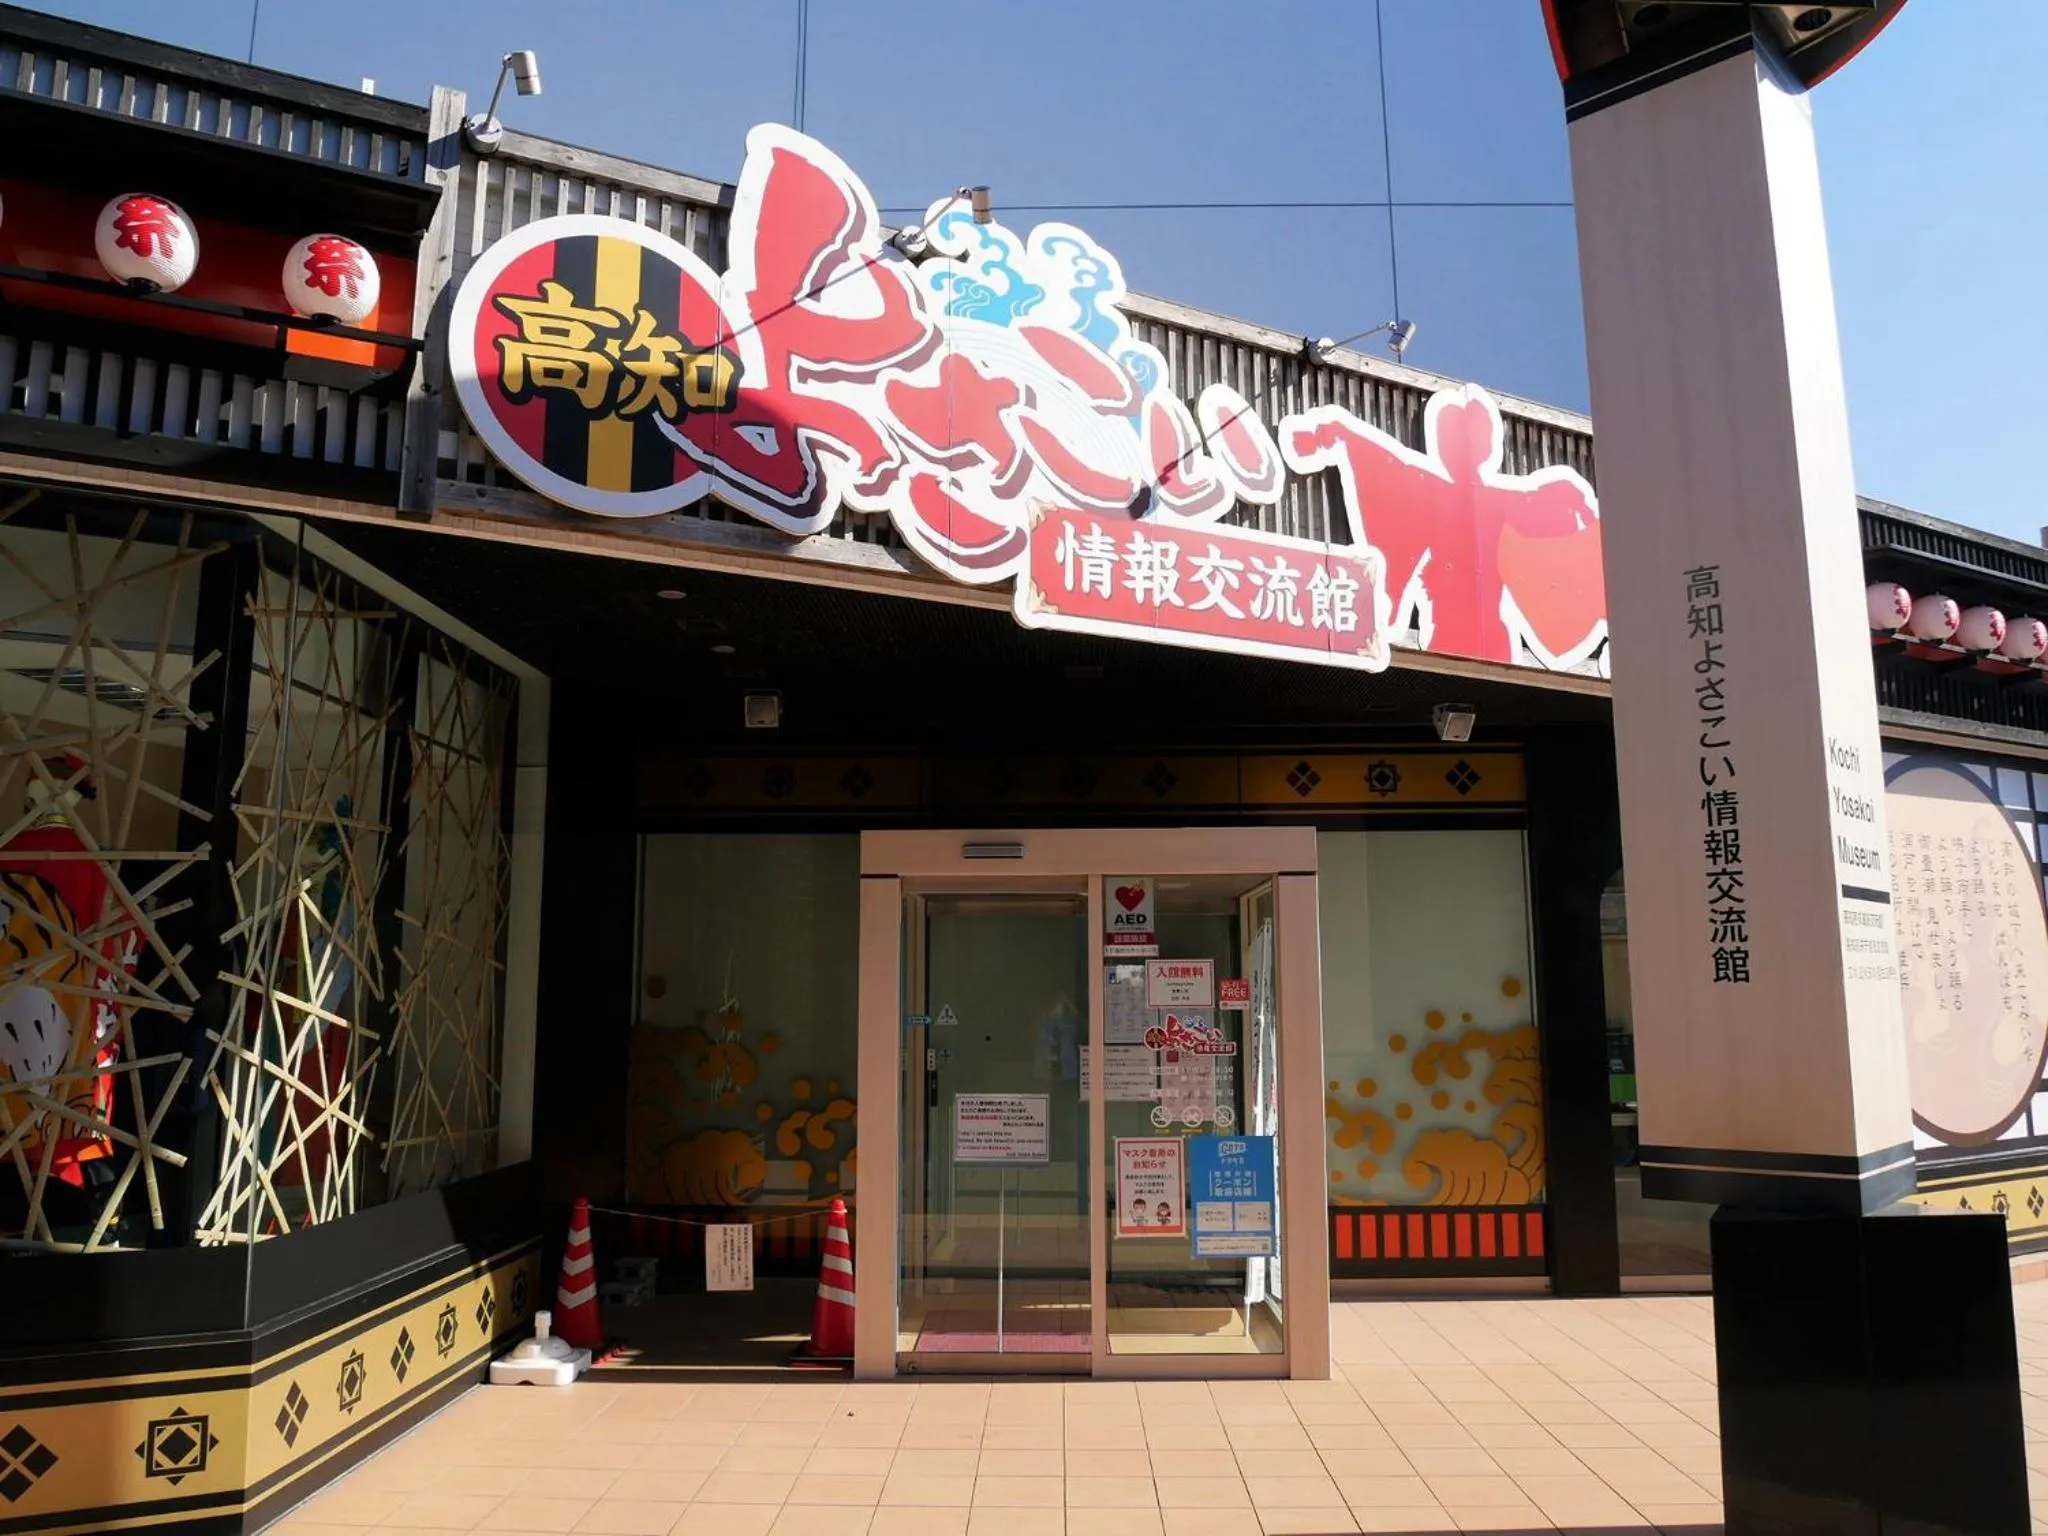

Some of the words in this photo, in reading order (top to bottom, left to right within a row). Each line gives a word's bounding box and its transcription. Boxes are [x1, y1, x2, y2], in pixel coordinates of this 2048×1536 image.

[495, 282, 736, 420] 高知
[1056, 520, 1359, 633] 情報交流館
[1683, 565, 1750, 983] 高知よさこい情報交流館
[1828, 737, 1861, 774] Kochi
[1832, 785, 1876, 824] Yosakoi
[1837, 835, 1882, 872] Museum
[1114, 914, 1147, 925] AED
[1221, 988, 1246, 998] FREE
